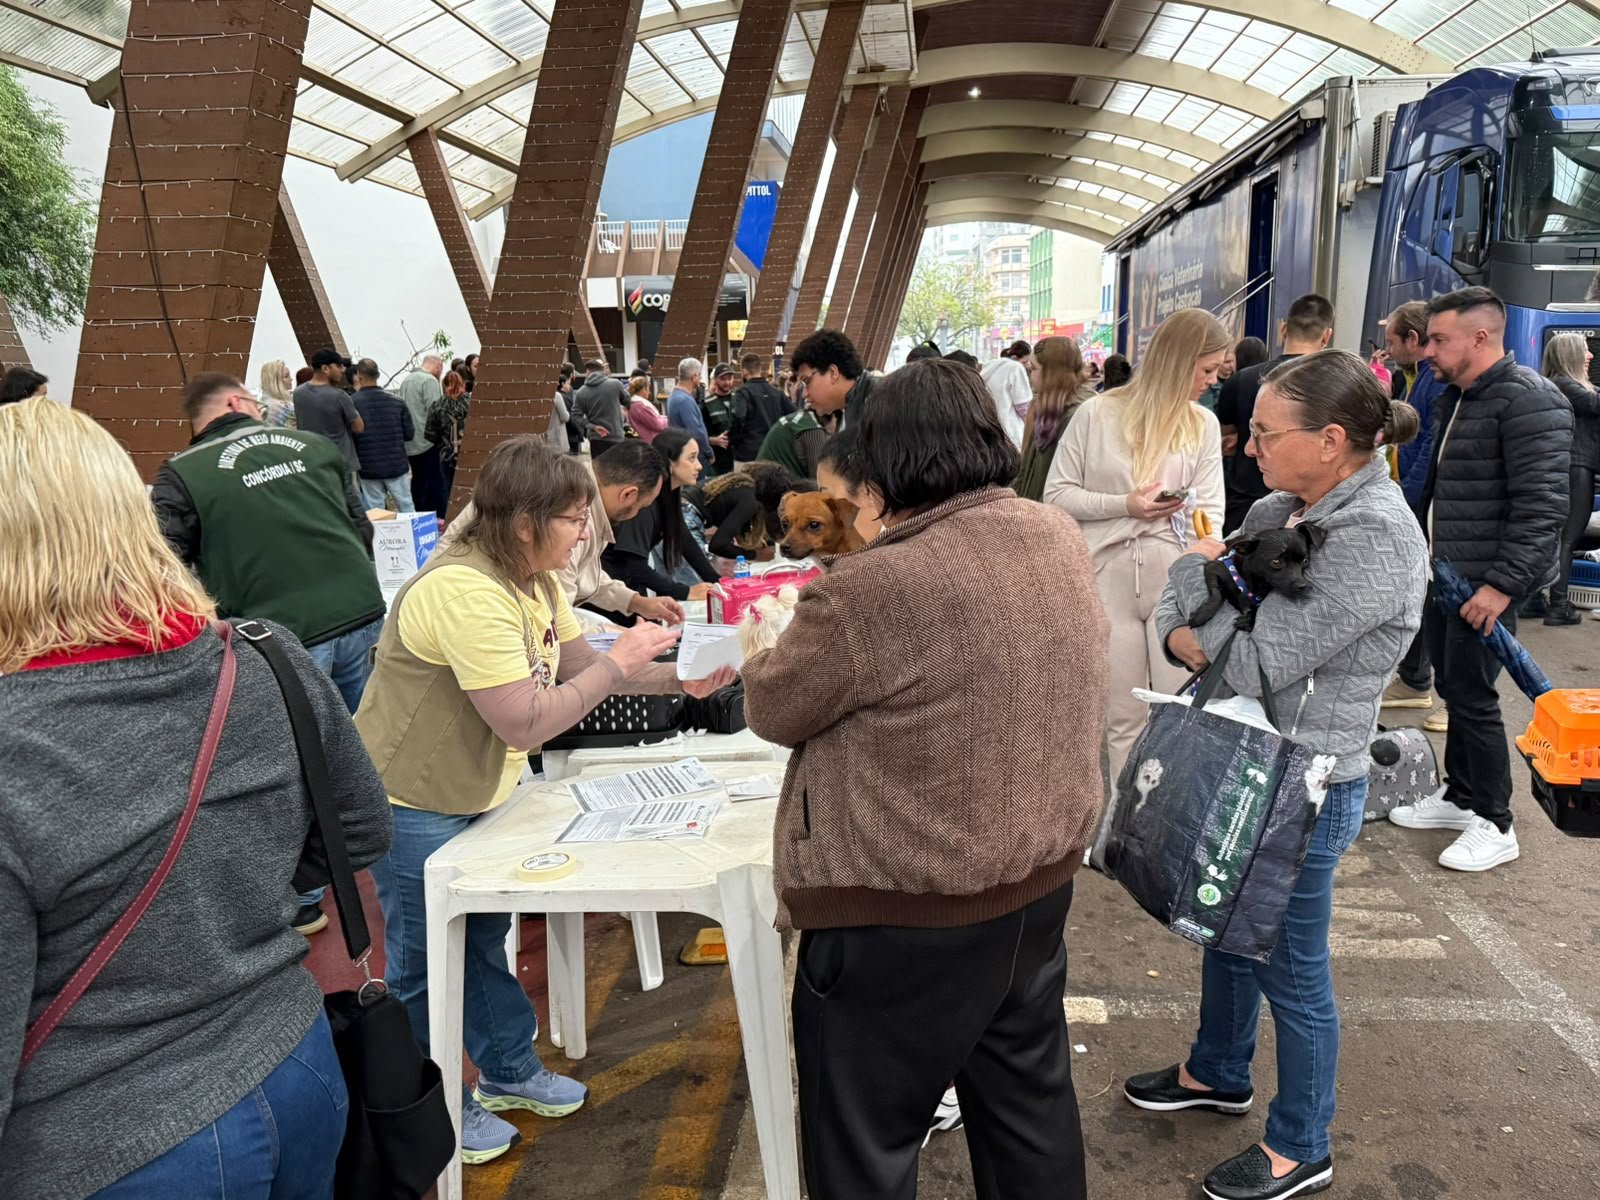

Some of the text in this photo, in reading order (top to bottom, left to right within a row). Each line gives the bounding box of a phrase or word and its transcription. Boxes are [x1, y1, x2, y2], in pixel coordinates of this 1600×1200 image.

[247, 433, 270, 447] MEIO
[270, 433, 308, 452] AMBIENTE
[242, 462, 292, 488] CONCÓRDIA
[293, 459, 306, 473] SC
